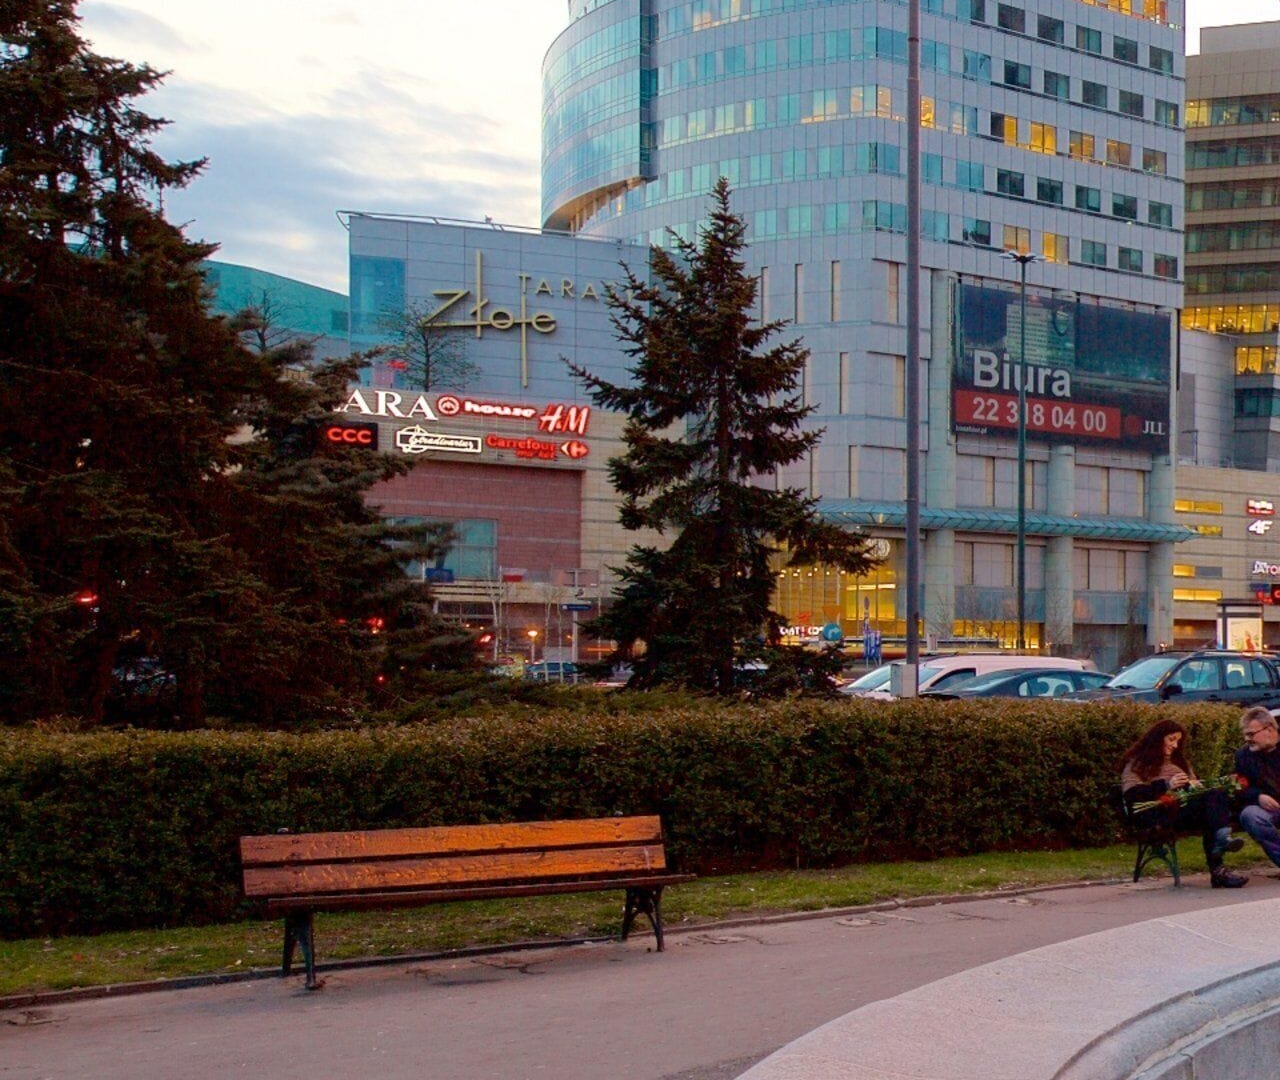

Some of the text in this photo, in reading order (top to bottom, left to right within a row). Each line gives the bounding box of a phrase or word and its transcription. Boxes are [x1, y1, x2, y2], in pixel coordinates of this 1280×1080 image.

[973, 350, 1071, 398] Biura
[333, 388, 440, 421] ARA
[972, 396, 999, 421] 22
[1051, 406, 1077, 430] 04
[1082, 409, 1107, 433] 00
[537, 404, 591, 435] H&M
[1142, 420, 1166, 436] JLL
[327, 426, 373, 445] CCC
[486, 434, 556, 452] Carrefour
[1247, 519, 1274, 535] 4F
